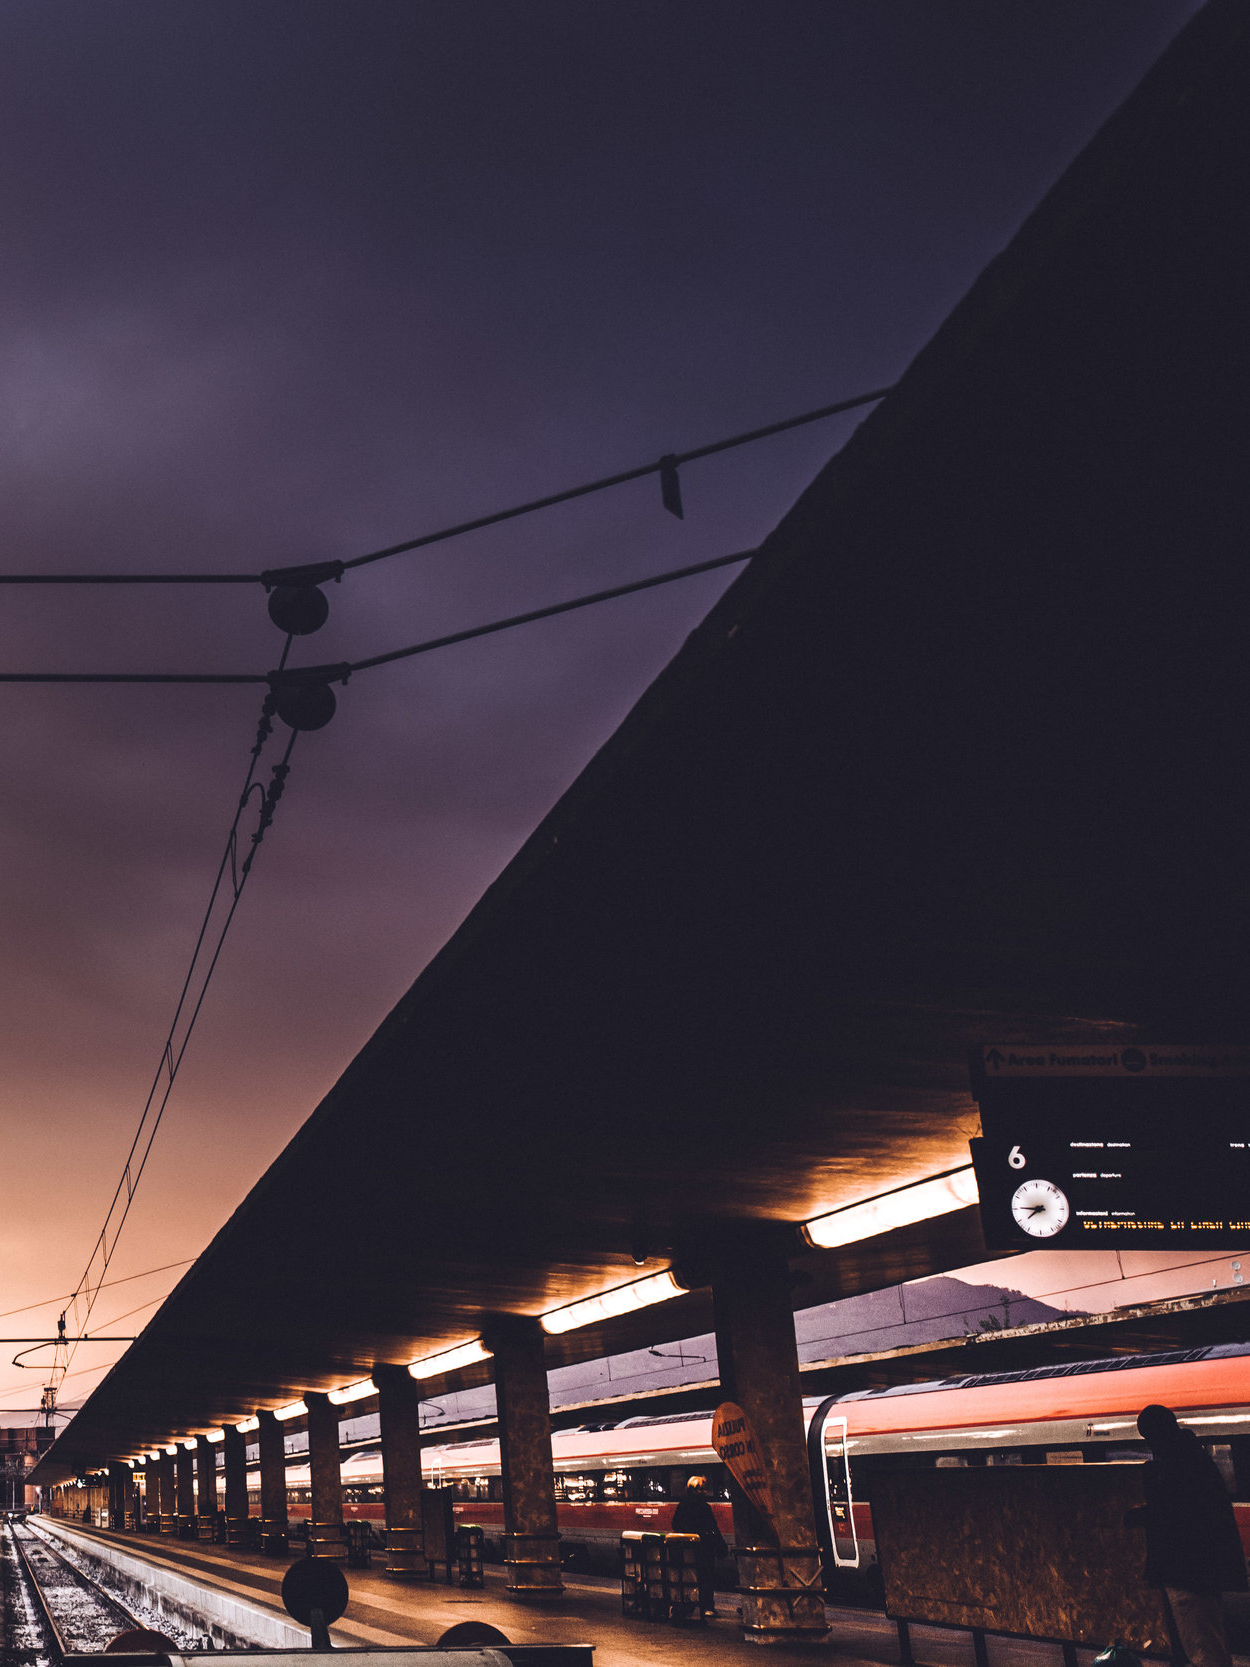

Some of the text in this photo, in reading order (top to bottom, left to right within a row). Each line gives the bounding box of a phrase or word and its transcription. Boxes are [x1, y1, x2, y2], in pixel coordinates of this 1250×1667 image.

[1008, 1053, 1046, 1067] Area
[1049, 1053, 1118, 1067] Fumatori
[1008, 1145, 1027, 1170] 6
